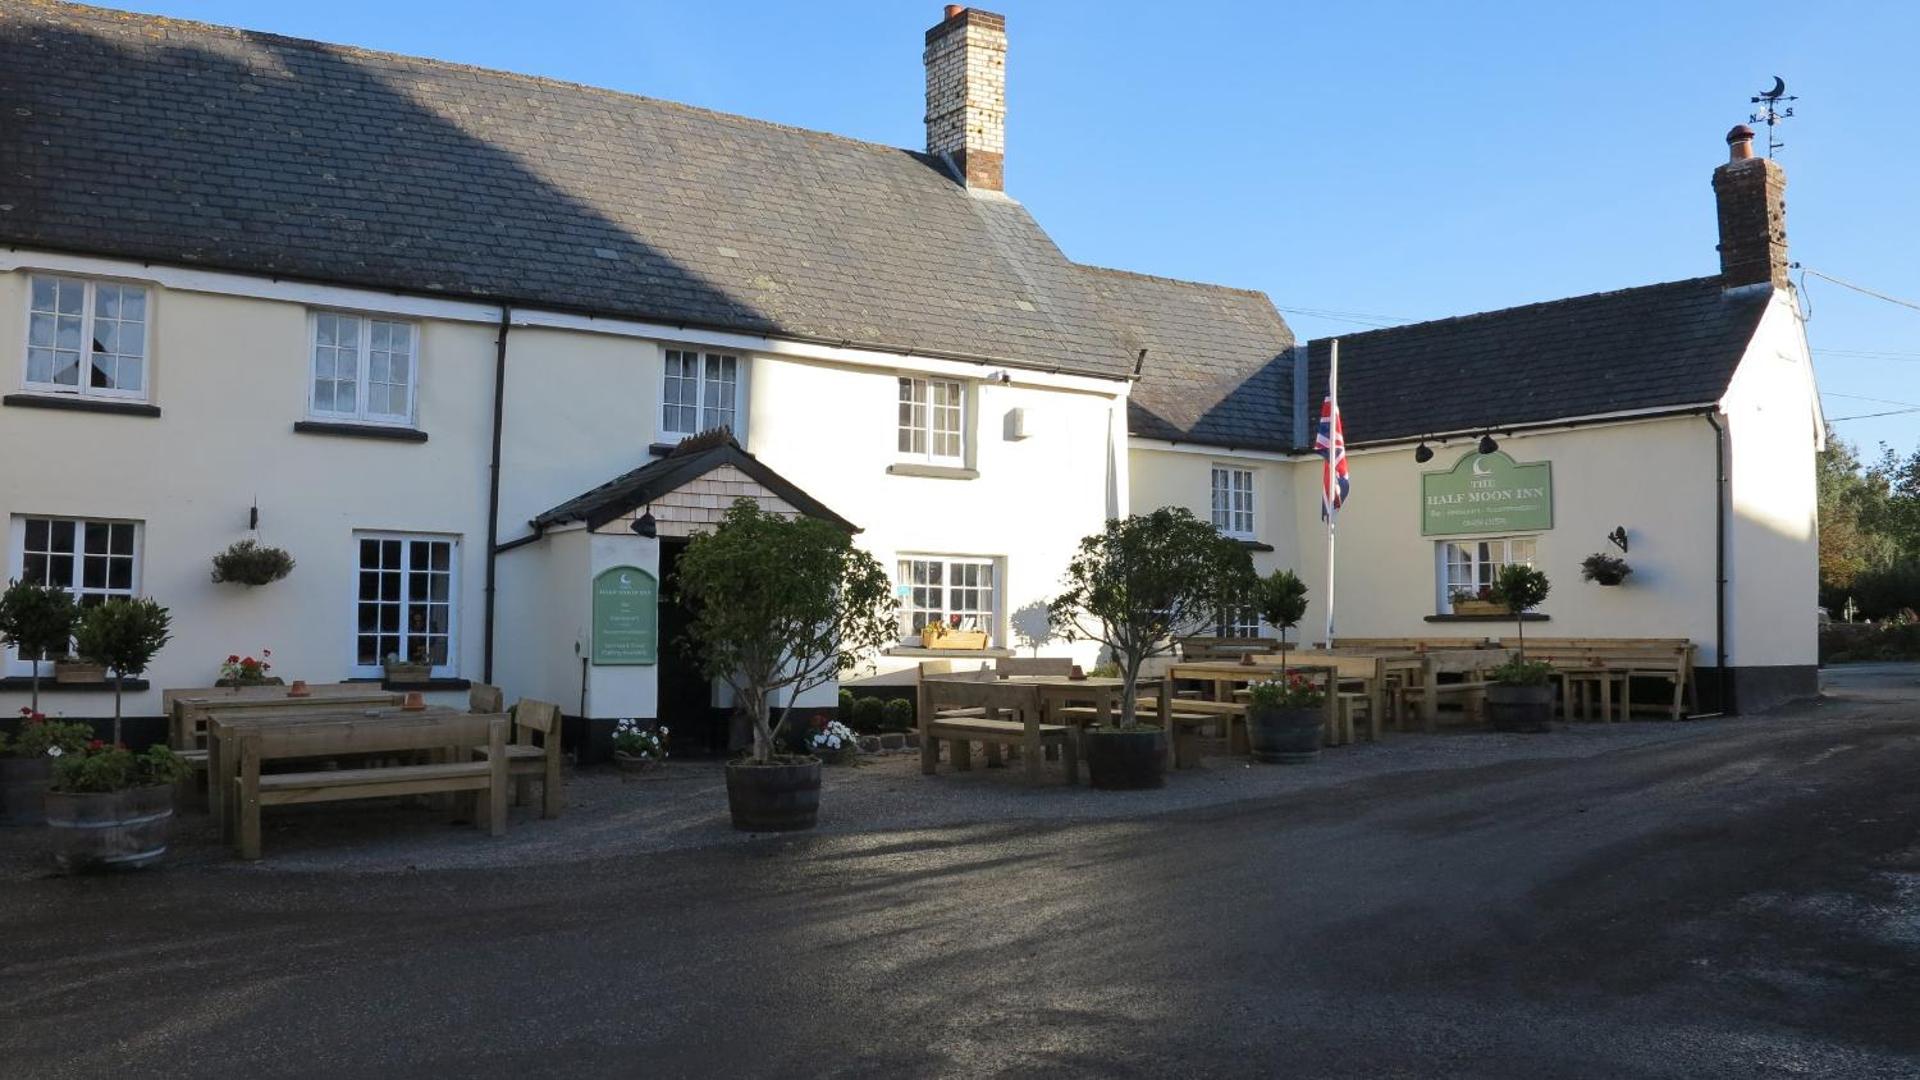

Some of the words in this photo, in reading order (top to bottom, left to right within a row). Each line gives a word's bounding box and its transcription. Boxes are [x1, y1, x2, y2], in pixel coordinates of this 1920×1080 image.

[1471, 480, 1496, 488] THE
[1427, 493, 1465, 505] HALF
[1468, 490, 1513, 503] MOON
[1517, 487, 1544, 499] INN
